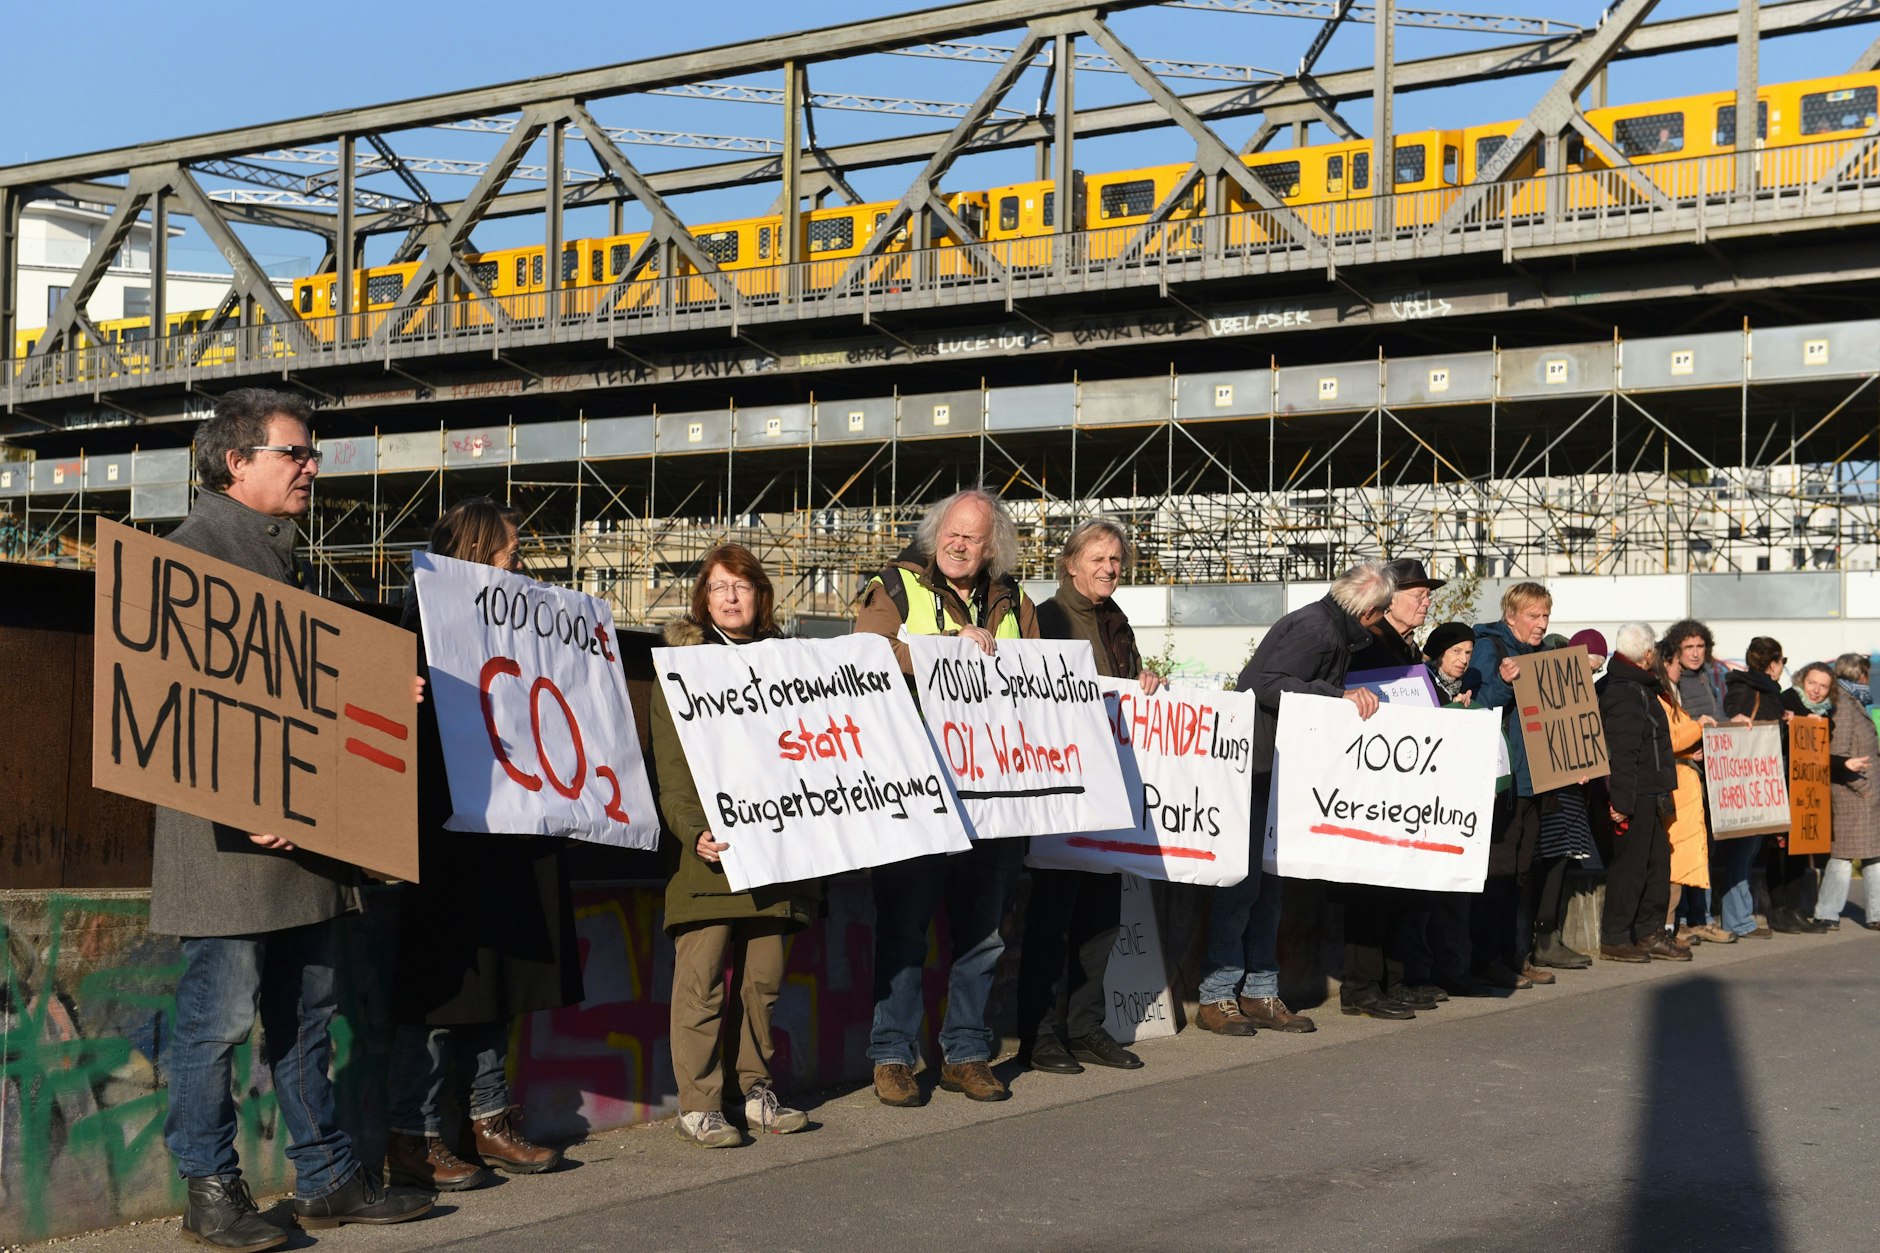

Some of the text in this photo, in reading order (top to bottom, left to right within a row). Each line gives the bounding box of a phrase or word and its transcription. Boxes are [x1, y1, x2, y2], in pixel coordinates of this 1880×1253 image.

[113, 540, 340, 720] URBANE
[995, 653, 1100, 708] Spekulation
[1534, 655, 1589, 712] KLIMA
[111, 663, 318, 827] MITTE
[778, 714, 863, 762] statt
[986, 720, 1082, 776] Wohnen
[1345, 734, 1443, 775] 100%
[1545, 711, 1606, 773] KILLER
[1794, 724, 1818, 752] KEINE
[717, 770, 948, 833] Bürgerbeteiligung
[1143, 783, 1220, 837] Parks
[1312, 787, 1477, 838] Versiegelung
[1764, 778, 1785, 807] SICH
[1800, 813, 1819, 840] HIER
[1113, 991, 1166, 1029] PROBLEME
